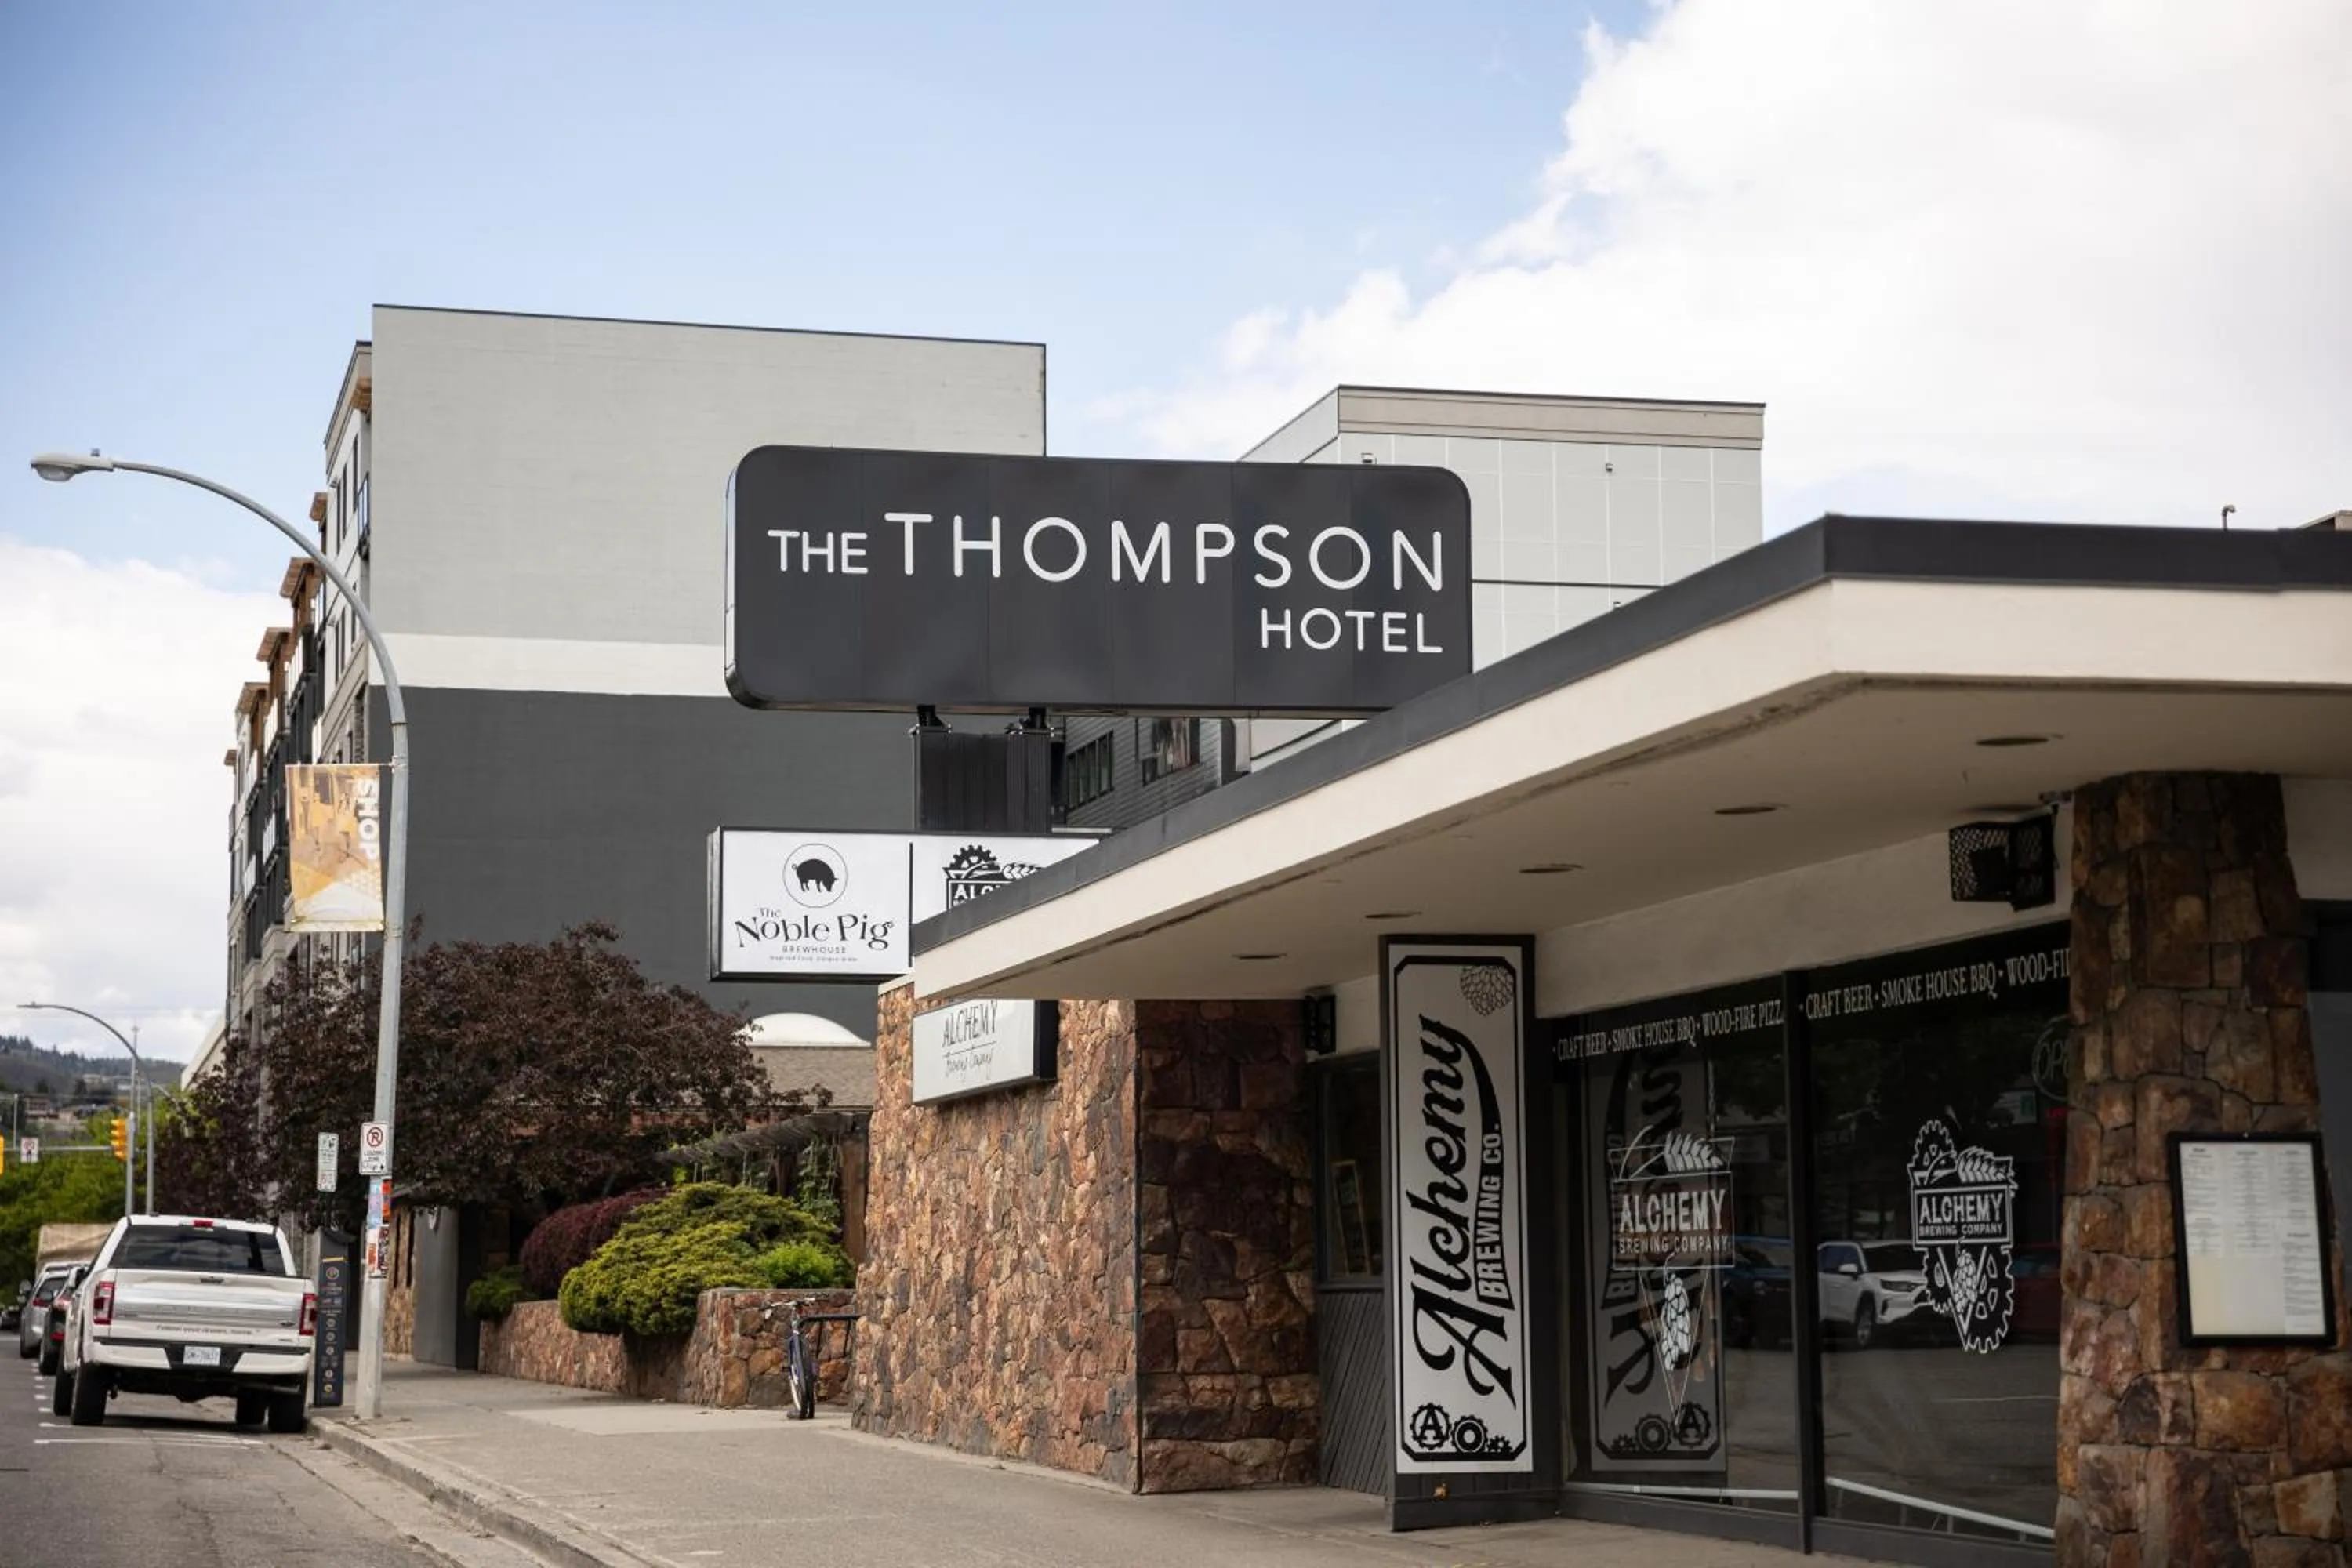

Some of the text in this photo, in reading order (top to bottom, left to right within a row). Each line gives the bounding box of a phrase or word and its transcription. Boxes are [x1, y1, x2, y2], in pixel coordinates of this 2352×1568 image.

[768, 512, 1443, 593] THE THOMPSON
[1261, 608, 1443, 653] HOTEL
[735, 913, 895, 951] Noble Pig
[782, 946, 847, 954] BREWHOUSE
[1805, 947, 2071, 1021] CRAFT BEER SMOKE HOUSE BBQ WOOD-FI
[942, 998, 998, 1048] ALCHEMY
[1556, 1033, 1584, 1062] CRAFT
[1585, 1031, 1607, 1058] BEER
[1613, 1025, 1643, 1053] SMOKE
[1644, 1018, 1675, 1048] HOUSE
[1677, 1015, 1697, 1048] BBQ
[1700, 1004, 1757, 1037] WOOD-FIRE
[1406, 1013, 1518, 1410] Alchemy
[1477, 1122, 1508, 1299] BREWING CO.
[1619, 1188, 1726, 1233] ALCHEMY
[1918, 1192, 2004, 1225] ALCHEMY
[1918, 1222, 2004, 1237] BREWING COMPANY
[1618, 1234, 1730, 1254] BREWING COMPANY
